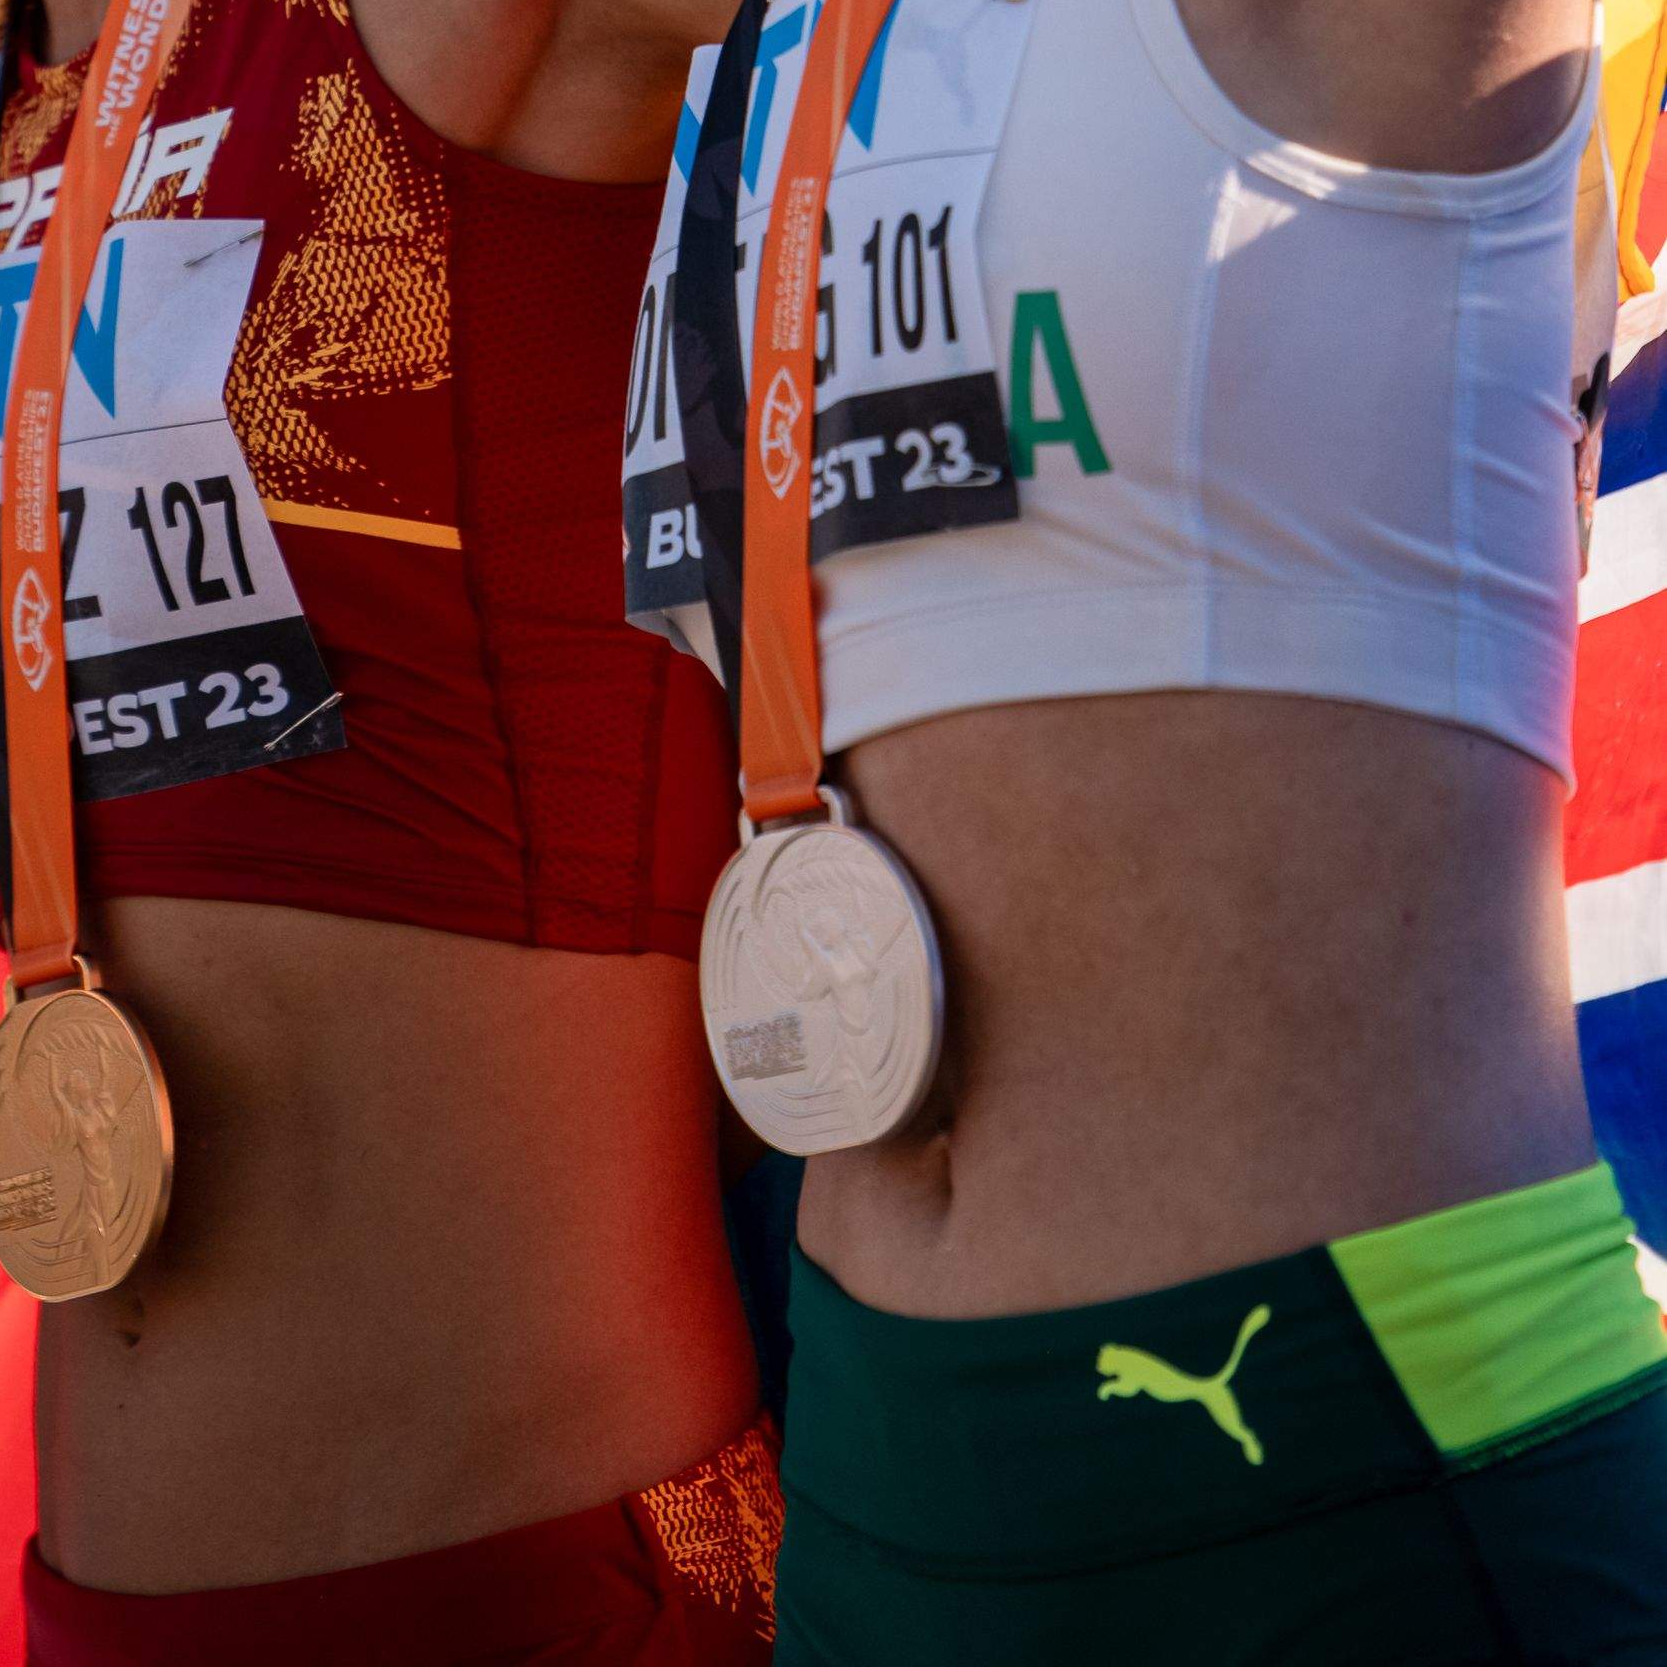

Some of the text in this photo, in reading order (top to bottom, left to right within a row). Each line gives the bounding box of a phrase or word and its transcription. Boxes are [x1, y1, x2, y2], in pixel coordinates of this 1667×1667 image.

[863, 205, 960, 358] 101
[895, 422, 975, 492] 23
[128, 474, 256, 612] 127
[198, 664, 289, 731] 23
